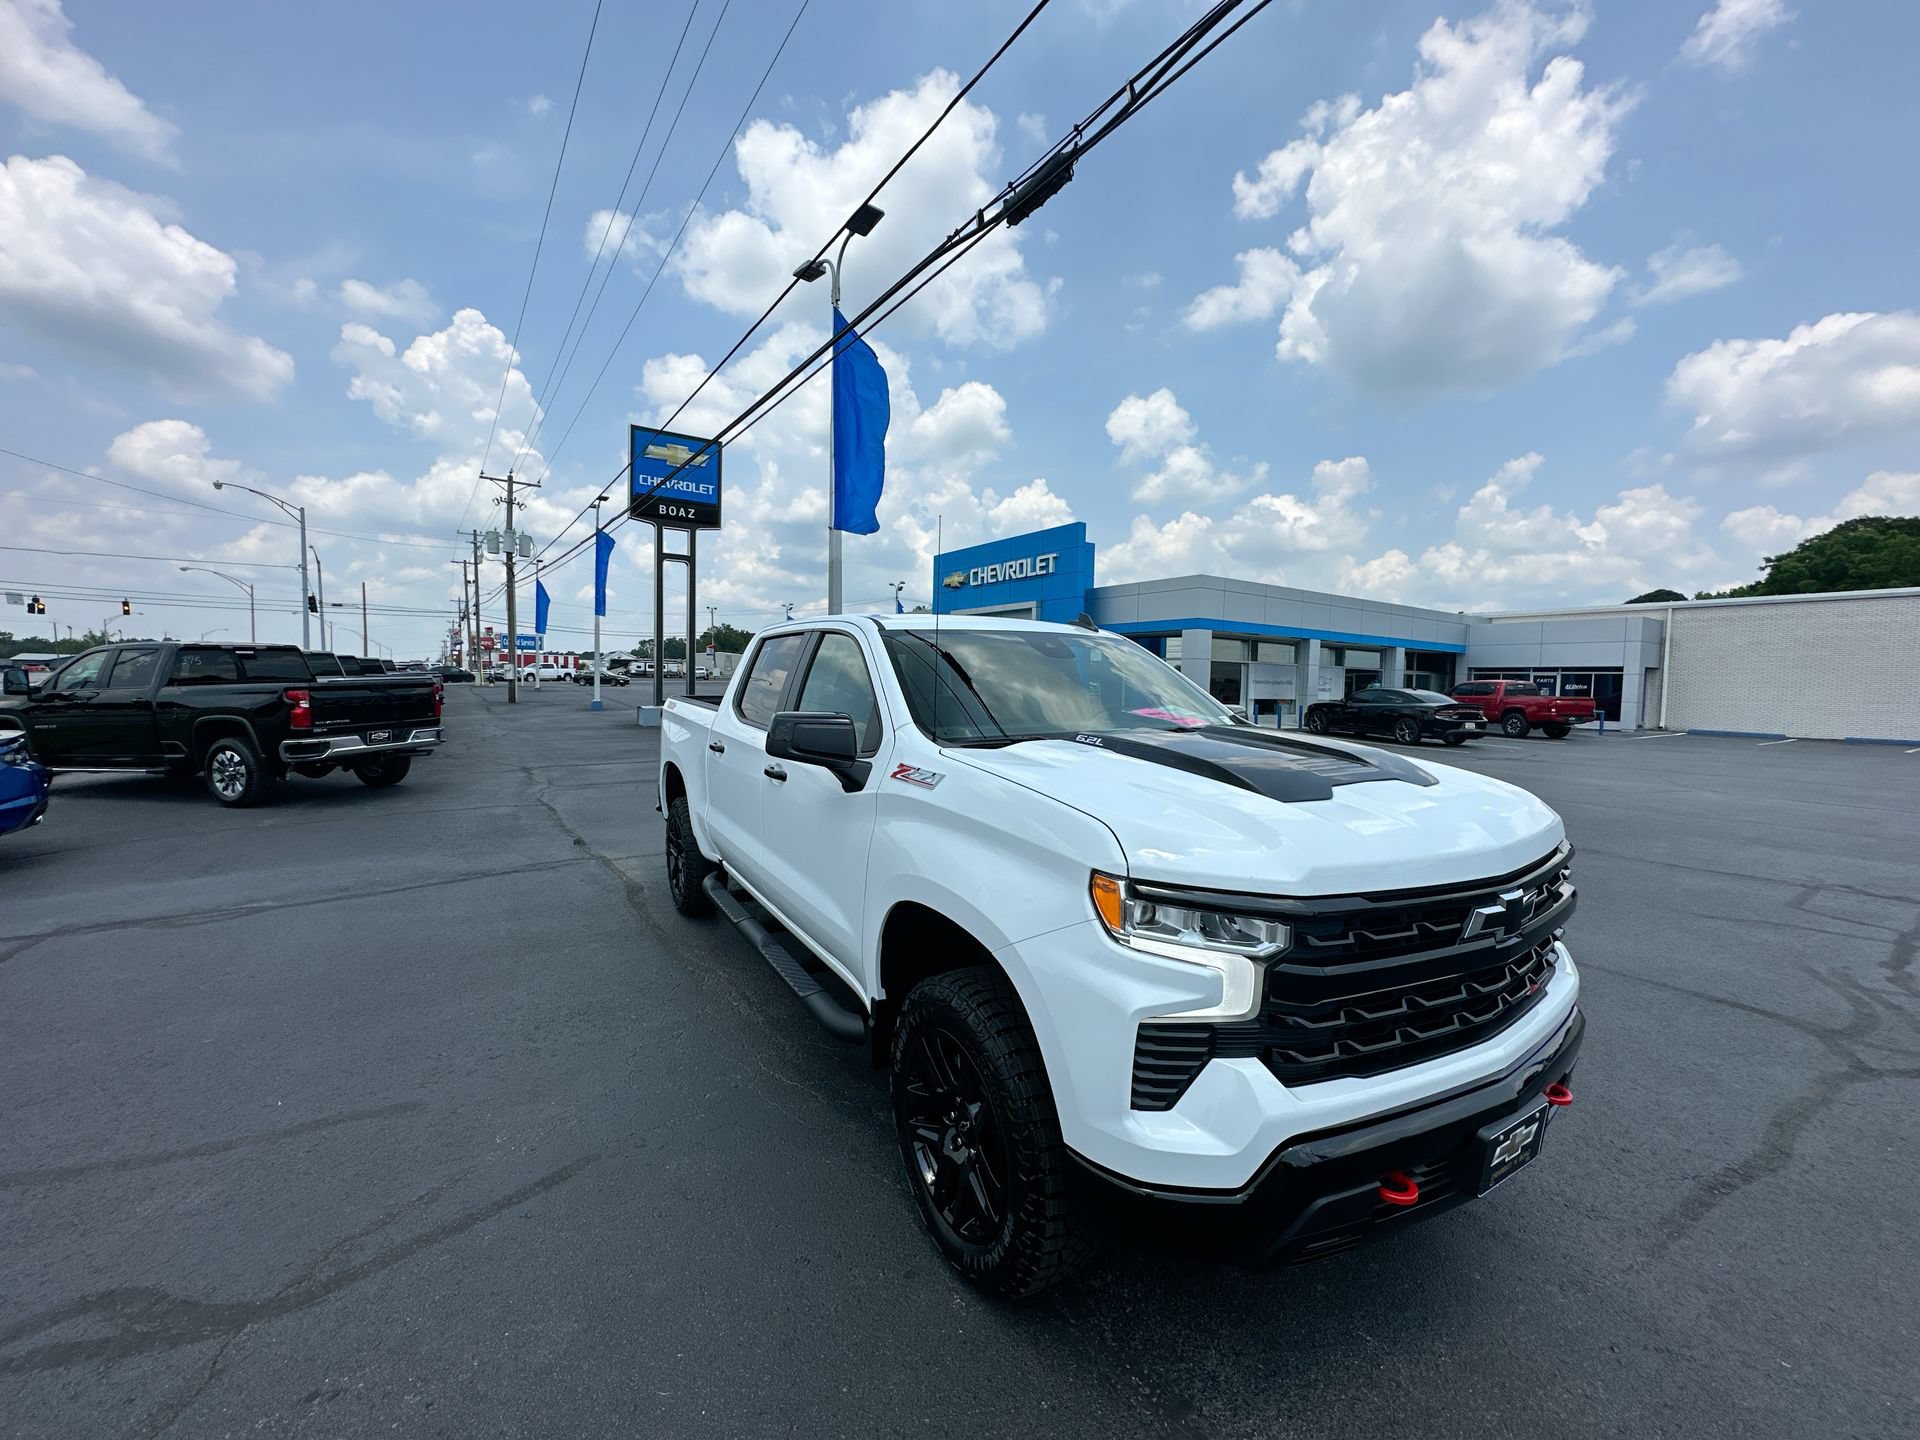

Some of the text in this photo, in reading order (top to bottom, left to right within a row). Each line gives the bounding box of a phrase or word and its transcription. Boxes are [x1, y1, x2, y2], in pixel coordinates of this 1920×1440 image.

[639, 474, 715, 496] CHEVROLET
[659, 504, 696, 519] BOAZ
[970, 553, 1057, 586] CHEVROLET
